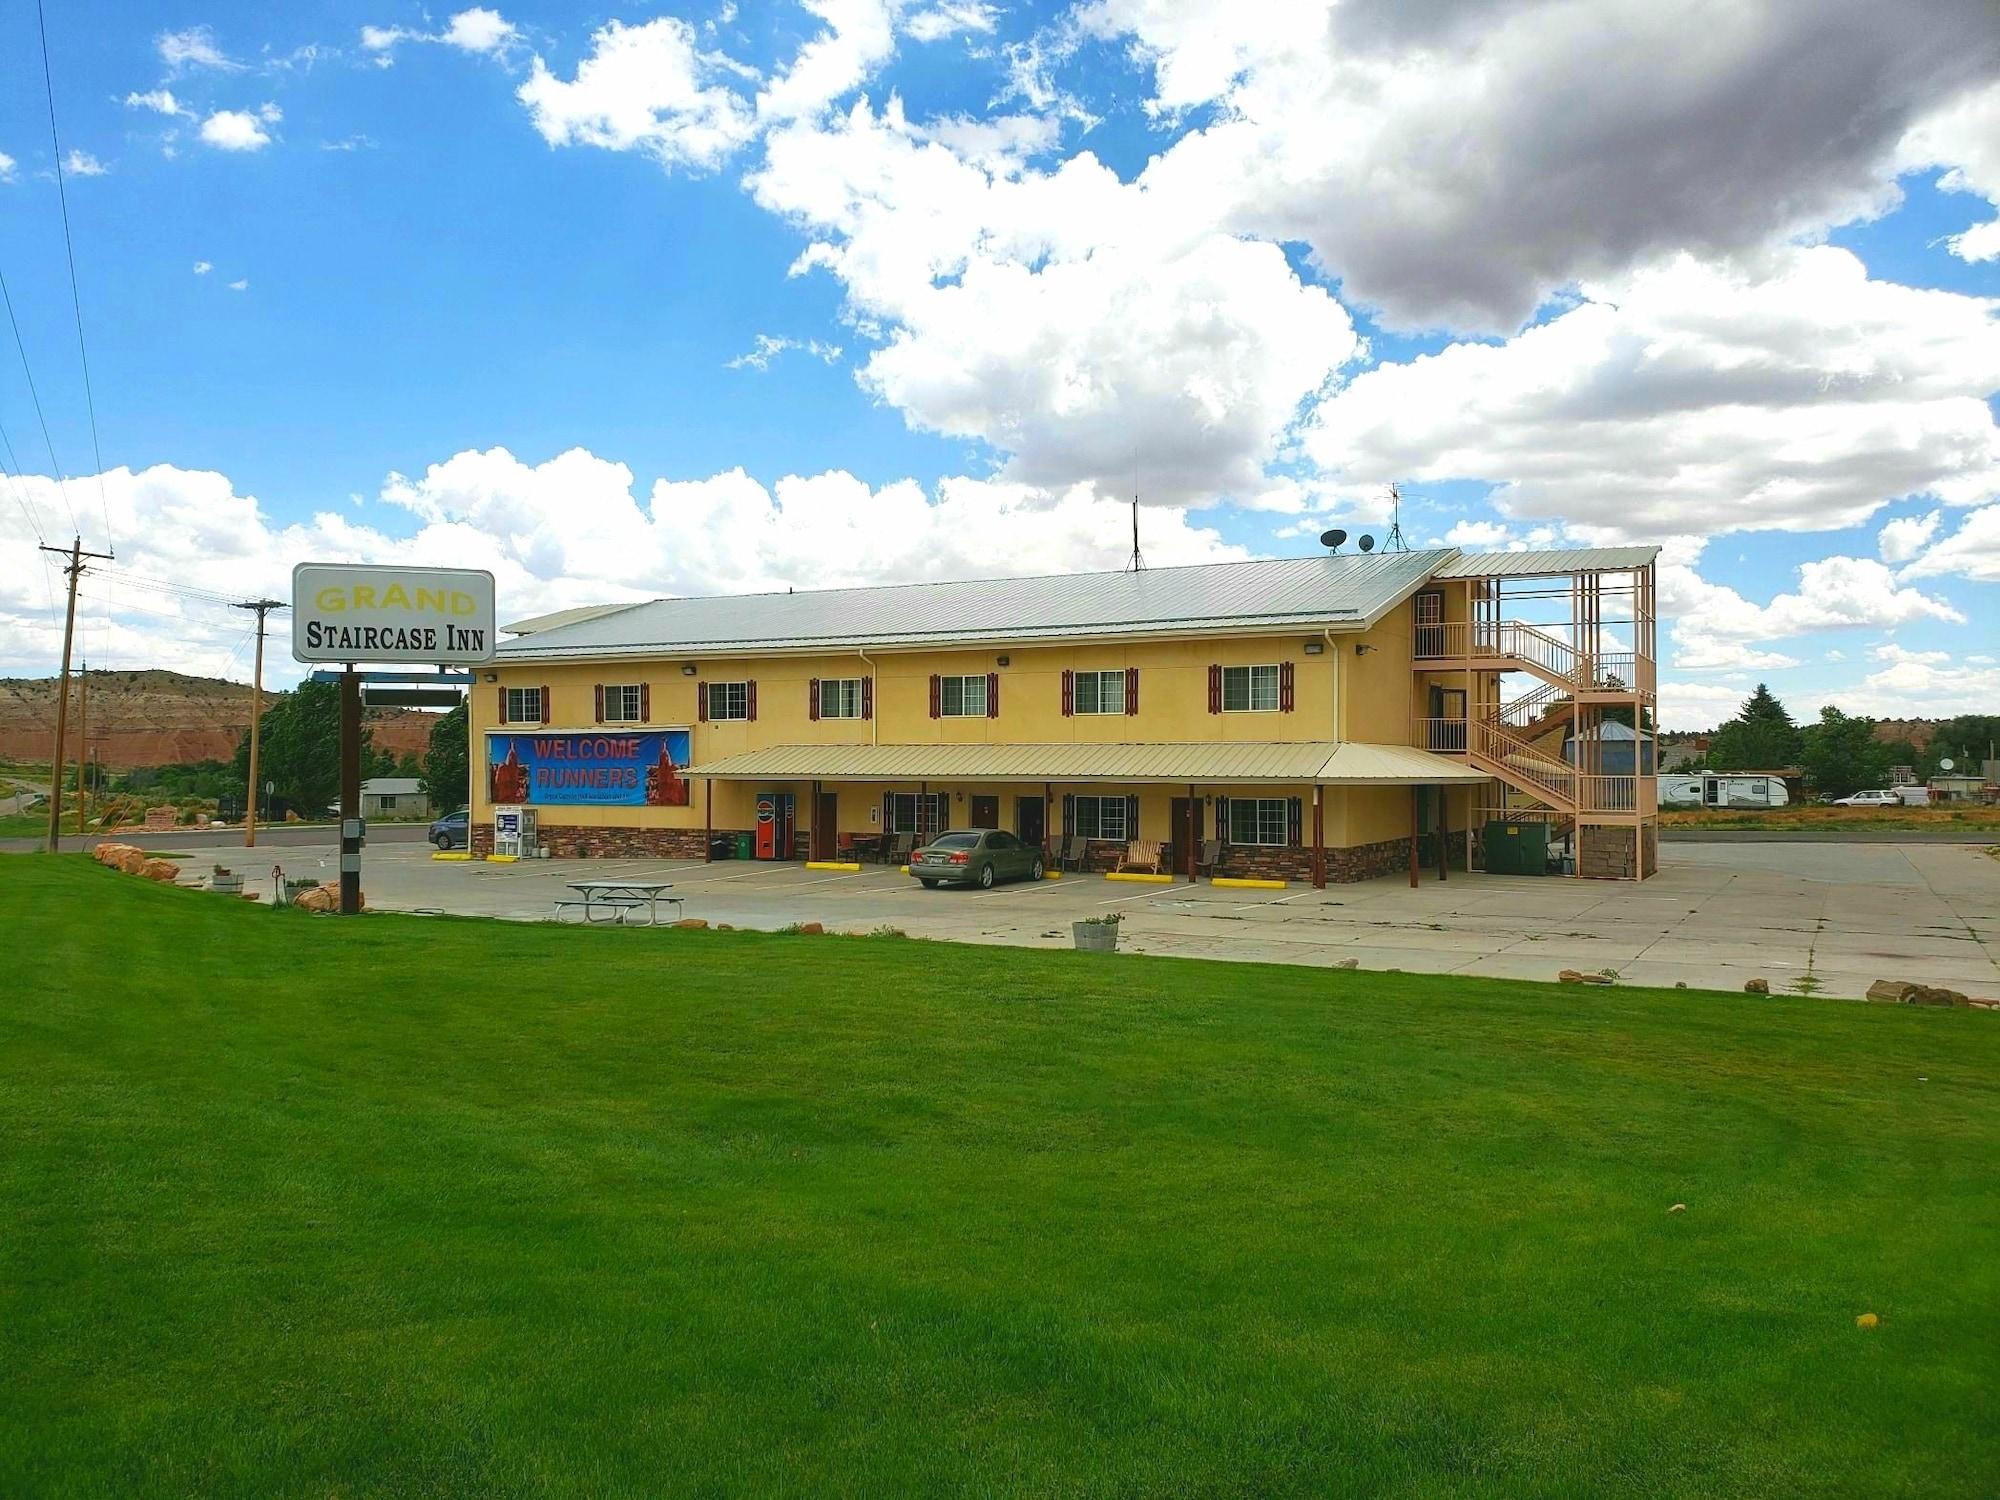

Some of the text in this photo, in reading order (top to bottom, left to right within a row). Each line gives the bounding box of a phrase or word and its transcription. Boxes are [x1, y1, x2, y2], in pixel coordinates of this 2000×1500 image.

[316, 583, 476, 616] GRAND
[306, 620, 485, 651] STAIRCASE INN
[534, 738, 640, 760] WELCOME
[538, 768, 637, 788] RUNNERS
